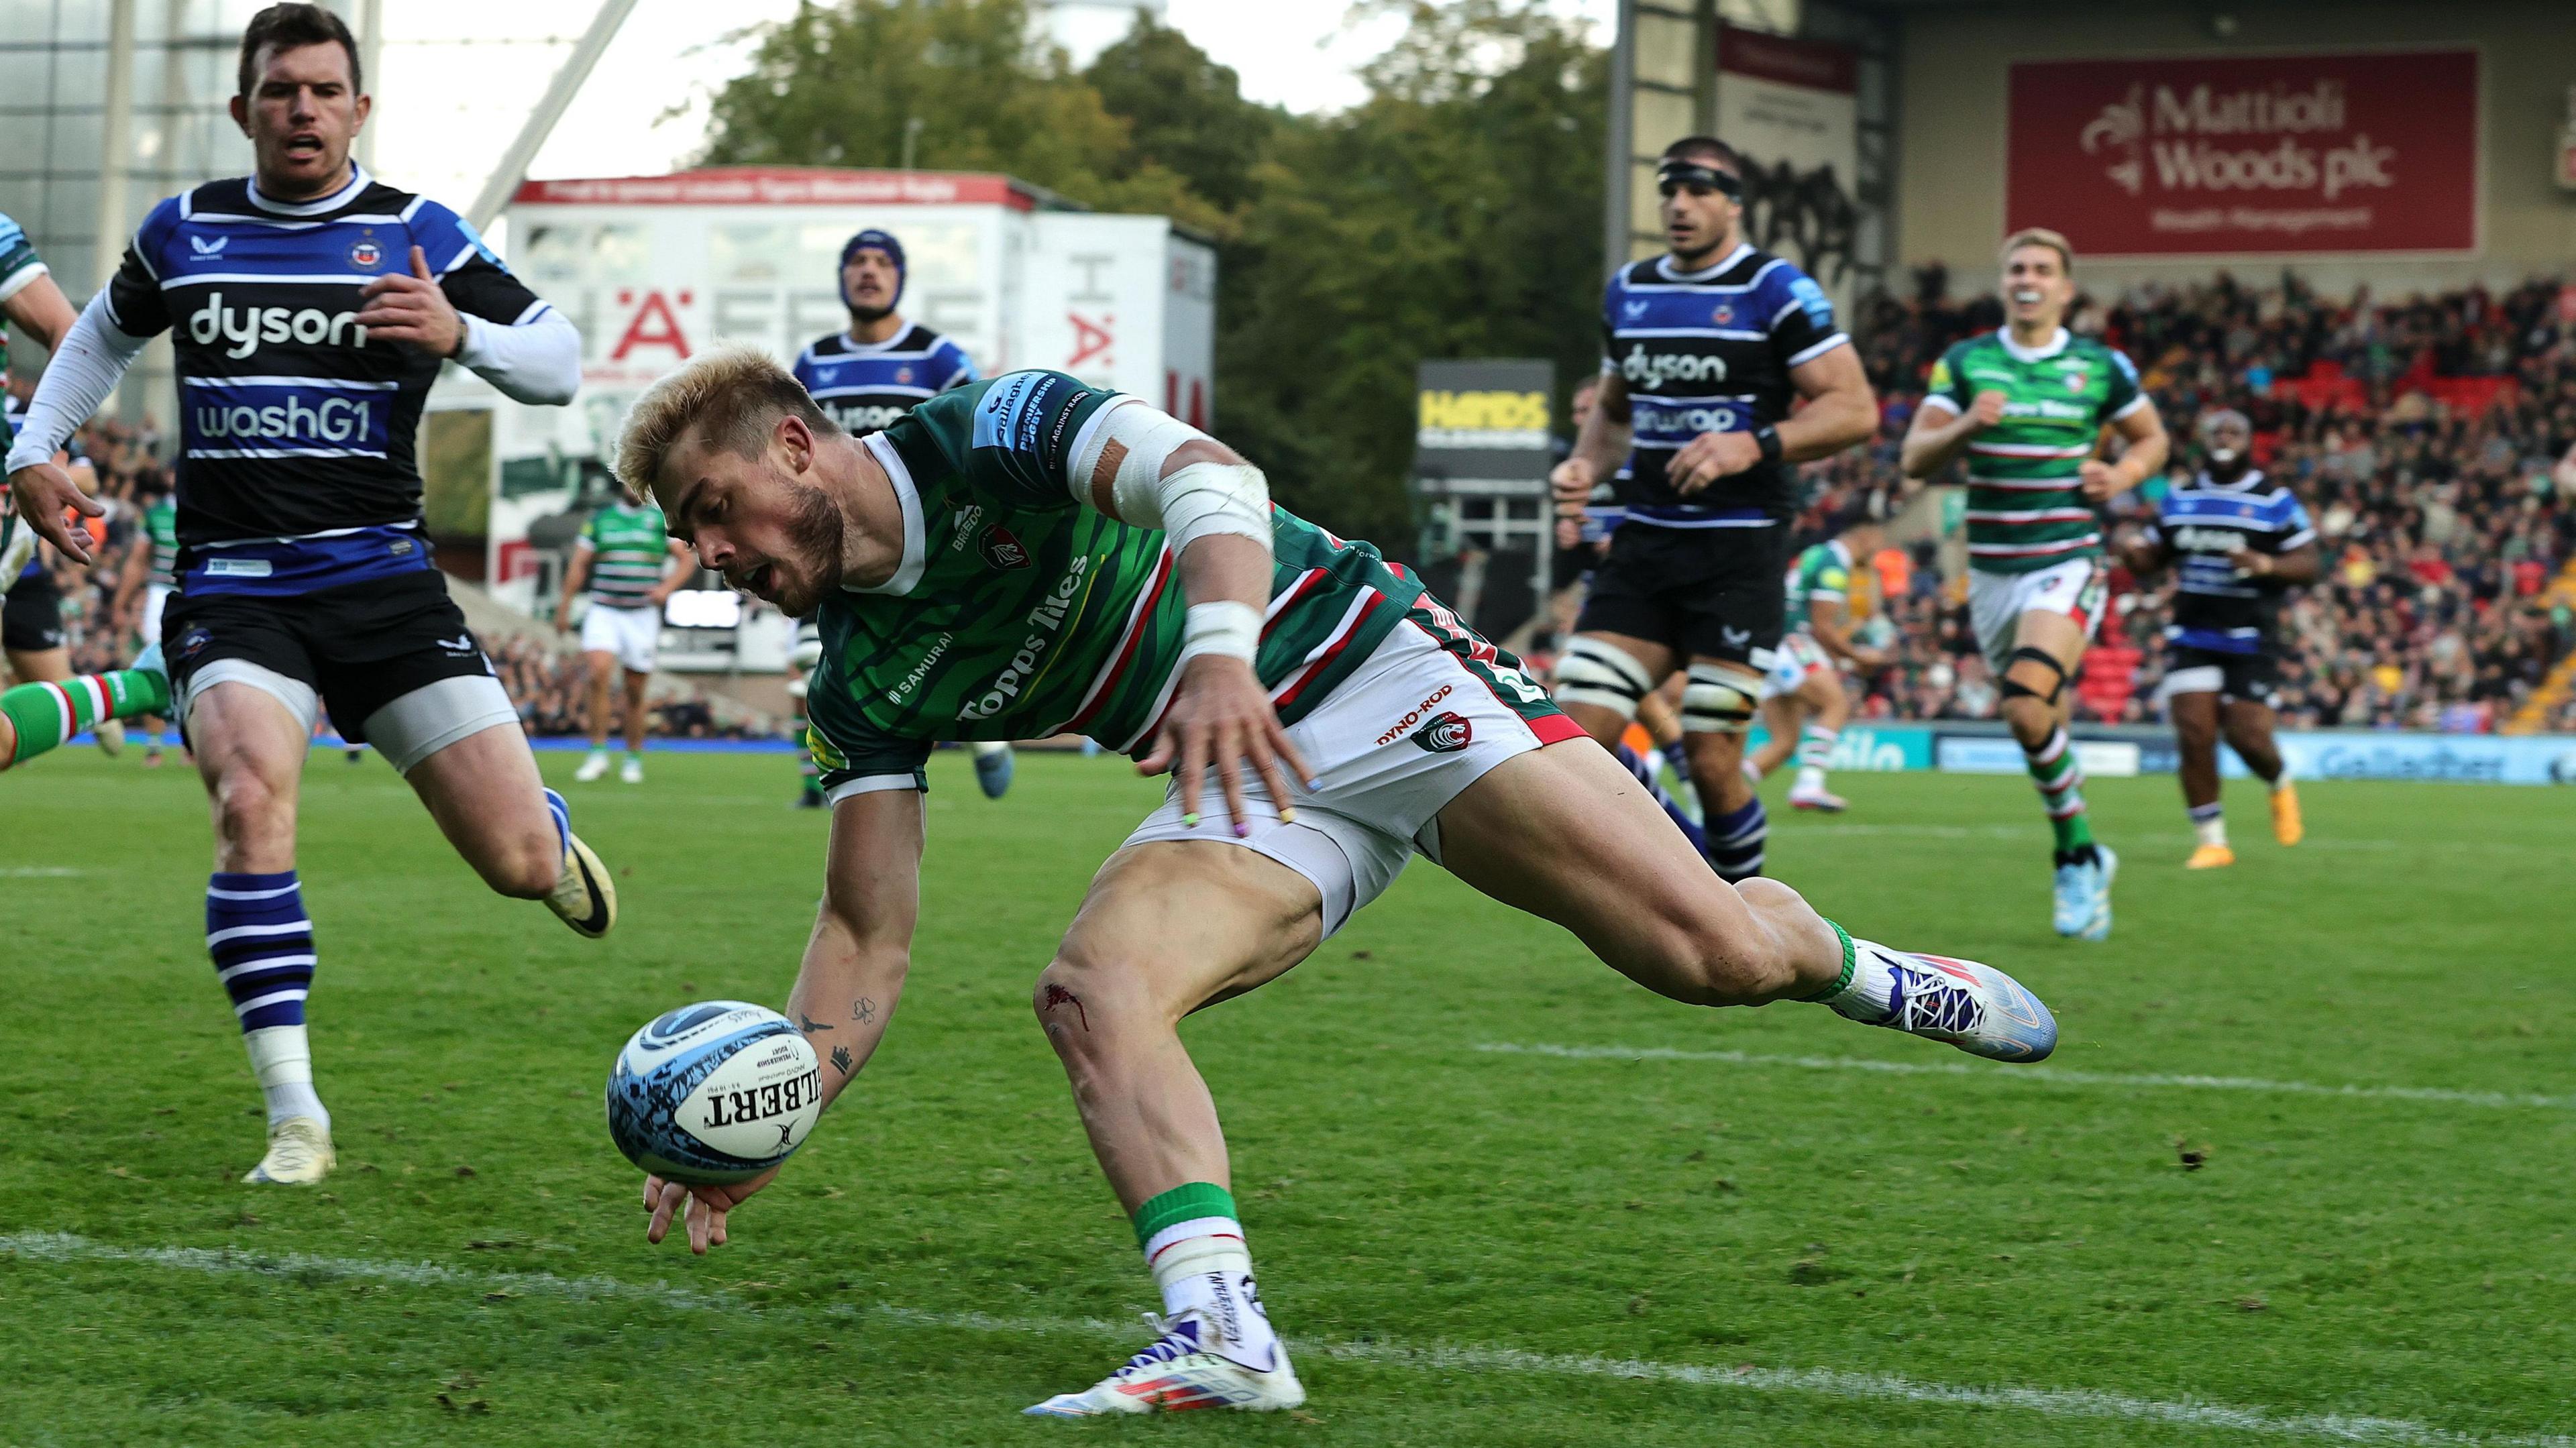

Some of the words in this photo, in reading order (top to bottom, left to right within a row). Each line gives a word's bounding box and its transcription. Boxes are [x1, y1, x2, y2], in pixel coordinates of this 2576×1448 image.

[2155, 78, 2343, 133] Mattioli
[2153, 140, 2318, 190] Woods
[2323, 134, 2397, 200] plc
[189, 291, 370, 359] dyson
[1622, 343, 1727, 390] dyson
[197, 394, 370, 442] washG1
[1020, 378, 1057, 451] PREMIERSHIP
[1029, 408, 1044, 452] UGBY
[1052, 406, 1071, 443] AGAINST
[952, 506, 984, 552] BREEDO
[899, 632, 953, 693] SAMURAI
[955, 633, 1046, 722] Topps
[1026, 555, 1087, 631] Tiles
[1375, 685, 1452, 745] DYNO-ROD
